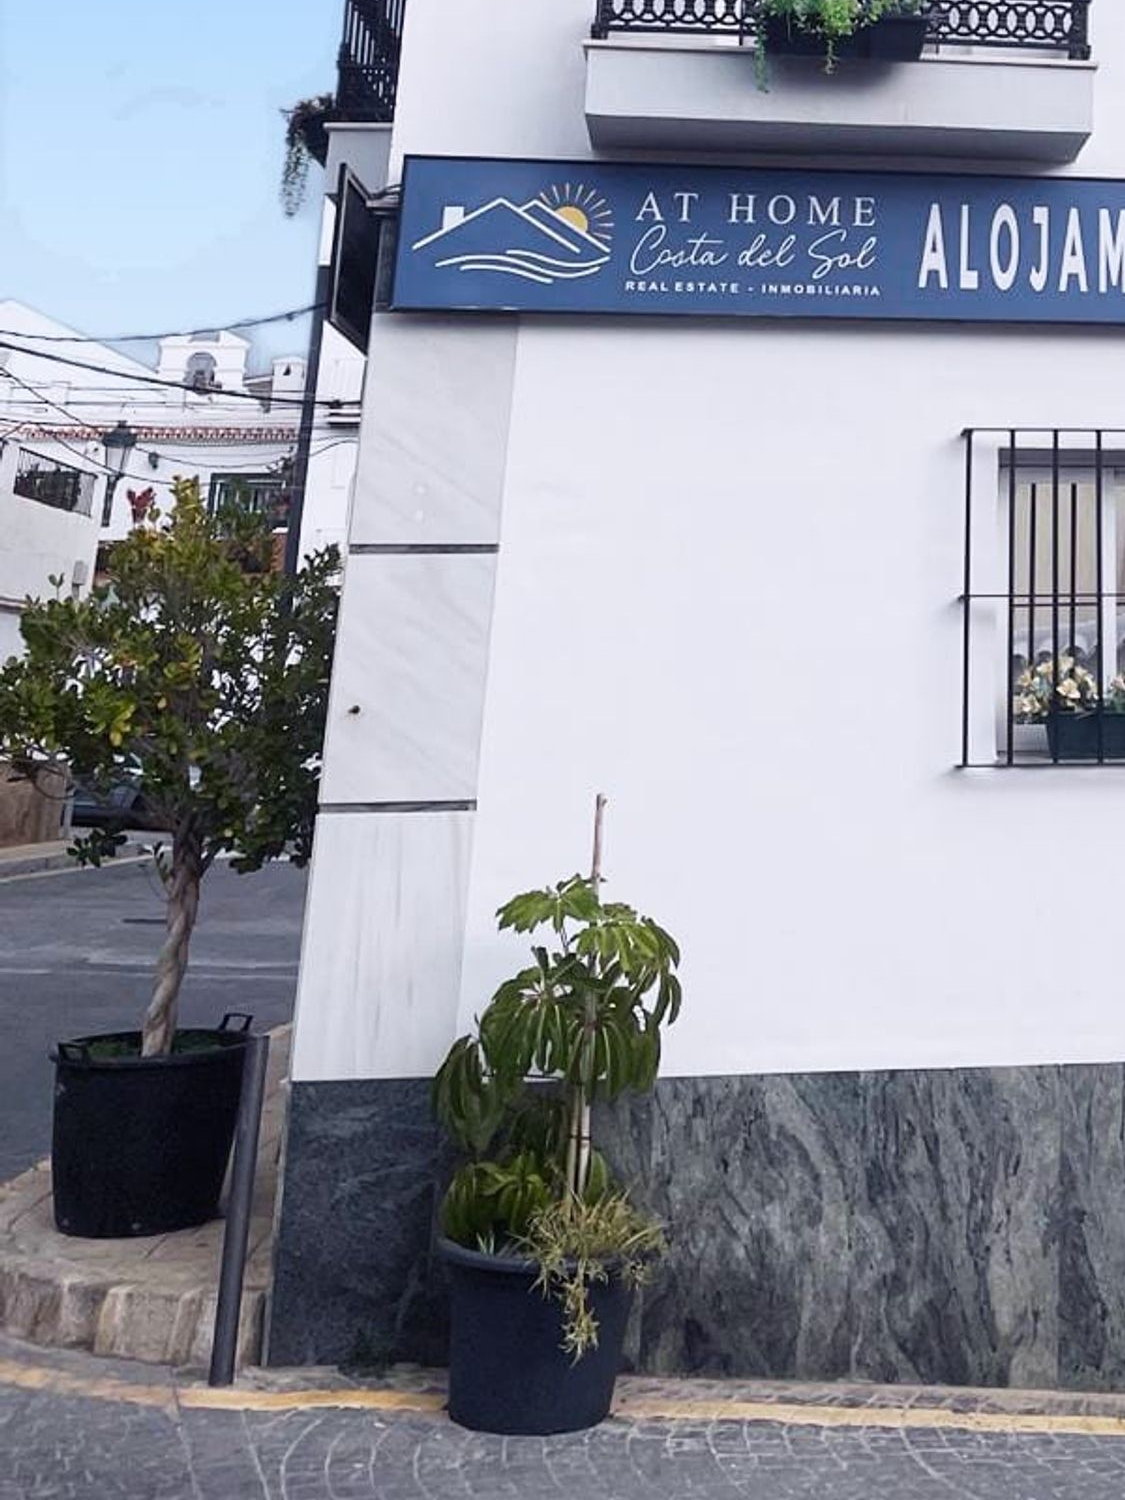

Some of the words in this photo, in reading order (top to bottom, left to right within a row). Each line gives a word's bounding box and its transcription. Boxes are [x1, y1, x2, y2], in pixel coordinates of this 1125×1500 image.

[635, 191, 700, 223] AT
[728, 194, 877, 227] HOME
[630, 224, 729, 277] Costa
[737, 234, 796, 268] del
[806, 228, 877, 280] Sol
[625, 280, 669, 293] REAL
[674, 282, 739, 294] ESTATE
[761, 284, 881, 296] INMOBILIARIA
